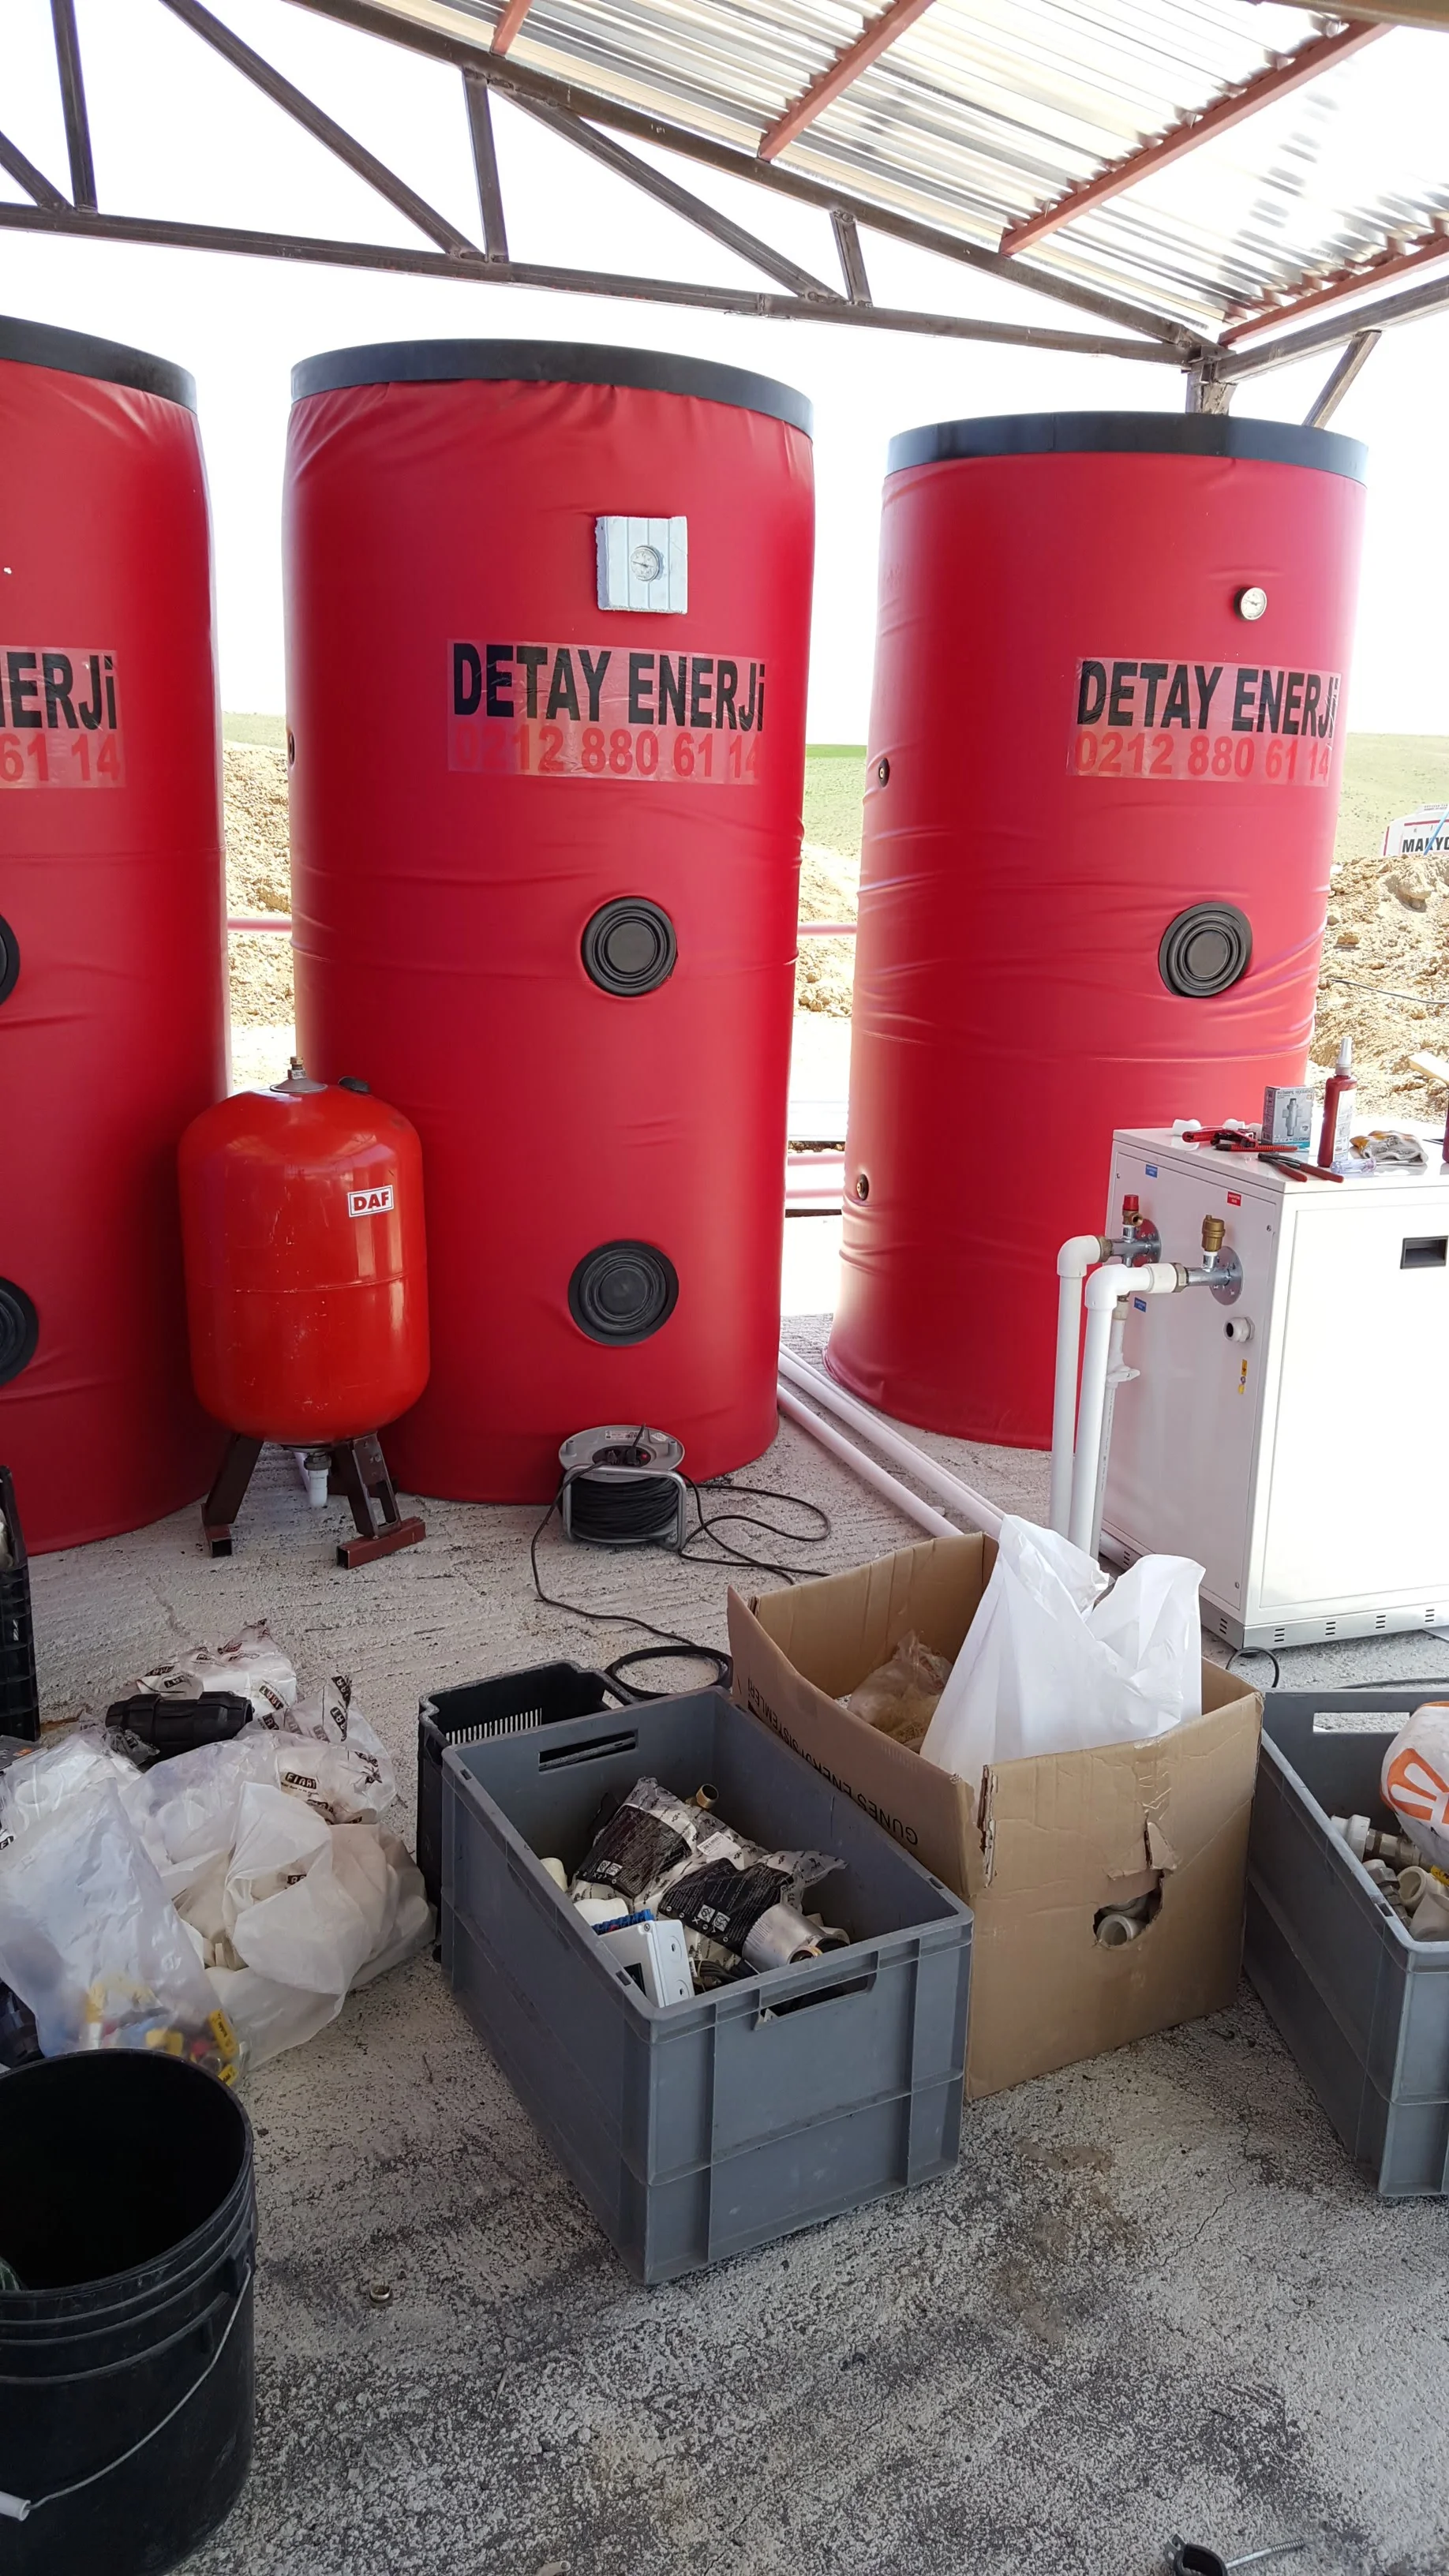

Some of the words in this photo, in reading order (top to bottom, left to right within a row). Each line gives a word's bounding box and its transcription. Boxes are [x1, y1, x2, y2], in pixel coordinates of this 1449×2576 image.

[454, 643, 612, 722] DETAY
[1077, 661, 1223, 729] DETAY
[0, 733, 49, 781] 61
[72, 734, 120, 781] 14
[455, 723, 564, 773] 0212
[582, 728, 658, 775] 880
[672, 733, 713, 777] 61
[729, 734, 759, 779] 14
[1075, 731, 1174, 775] 0212
[1187, 736, 1255, 777] 880
[1265, 739, 1298, 781] 61
[1310, 742, 1330, 781] 14
[354, 1191, 389, 1211] DAF
[286, 1773, 316, 1789] FIRAT
